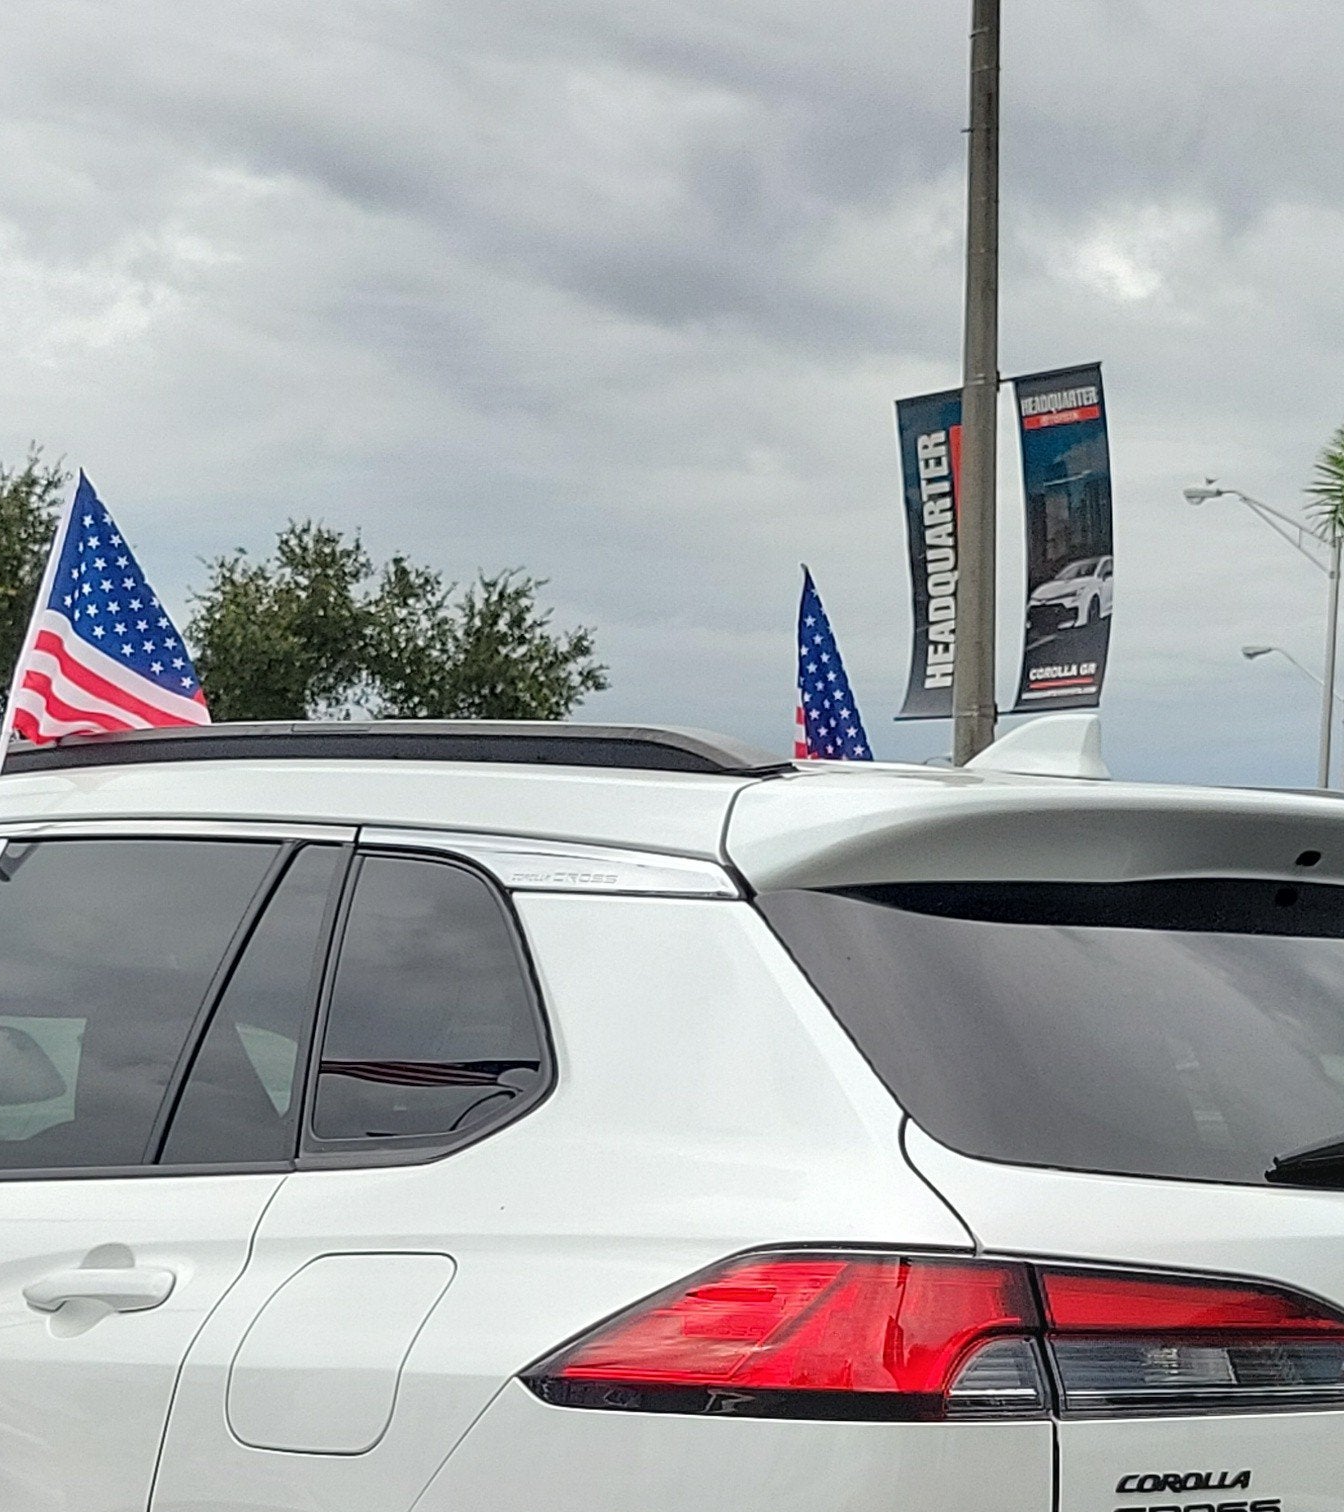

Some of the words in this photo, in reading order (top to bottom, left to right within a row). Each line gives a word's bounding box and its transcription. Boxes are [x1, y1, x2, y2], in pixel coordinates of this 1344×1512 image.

[918, 430, 959, 690] HEADQUARTER
[1029, 663, 1078, 681] COROLLA
[1115, 1470, 1252, 1494] COROLLA
